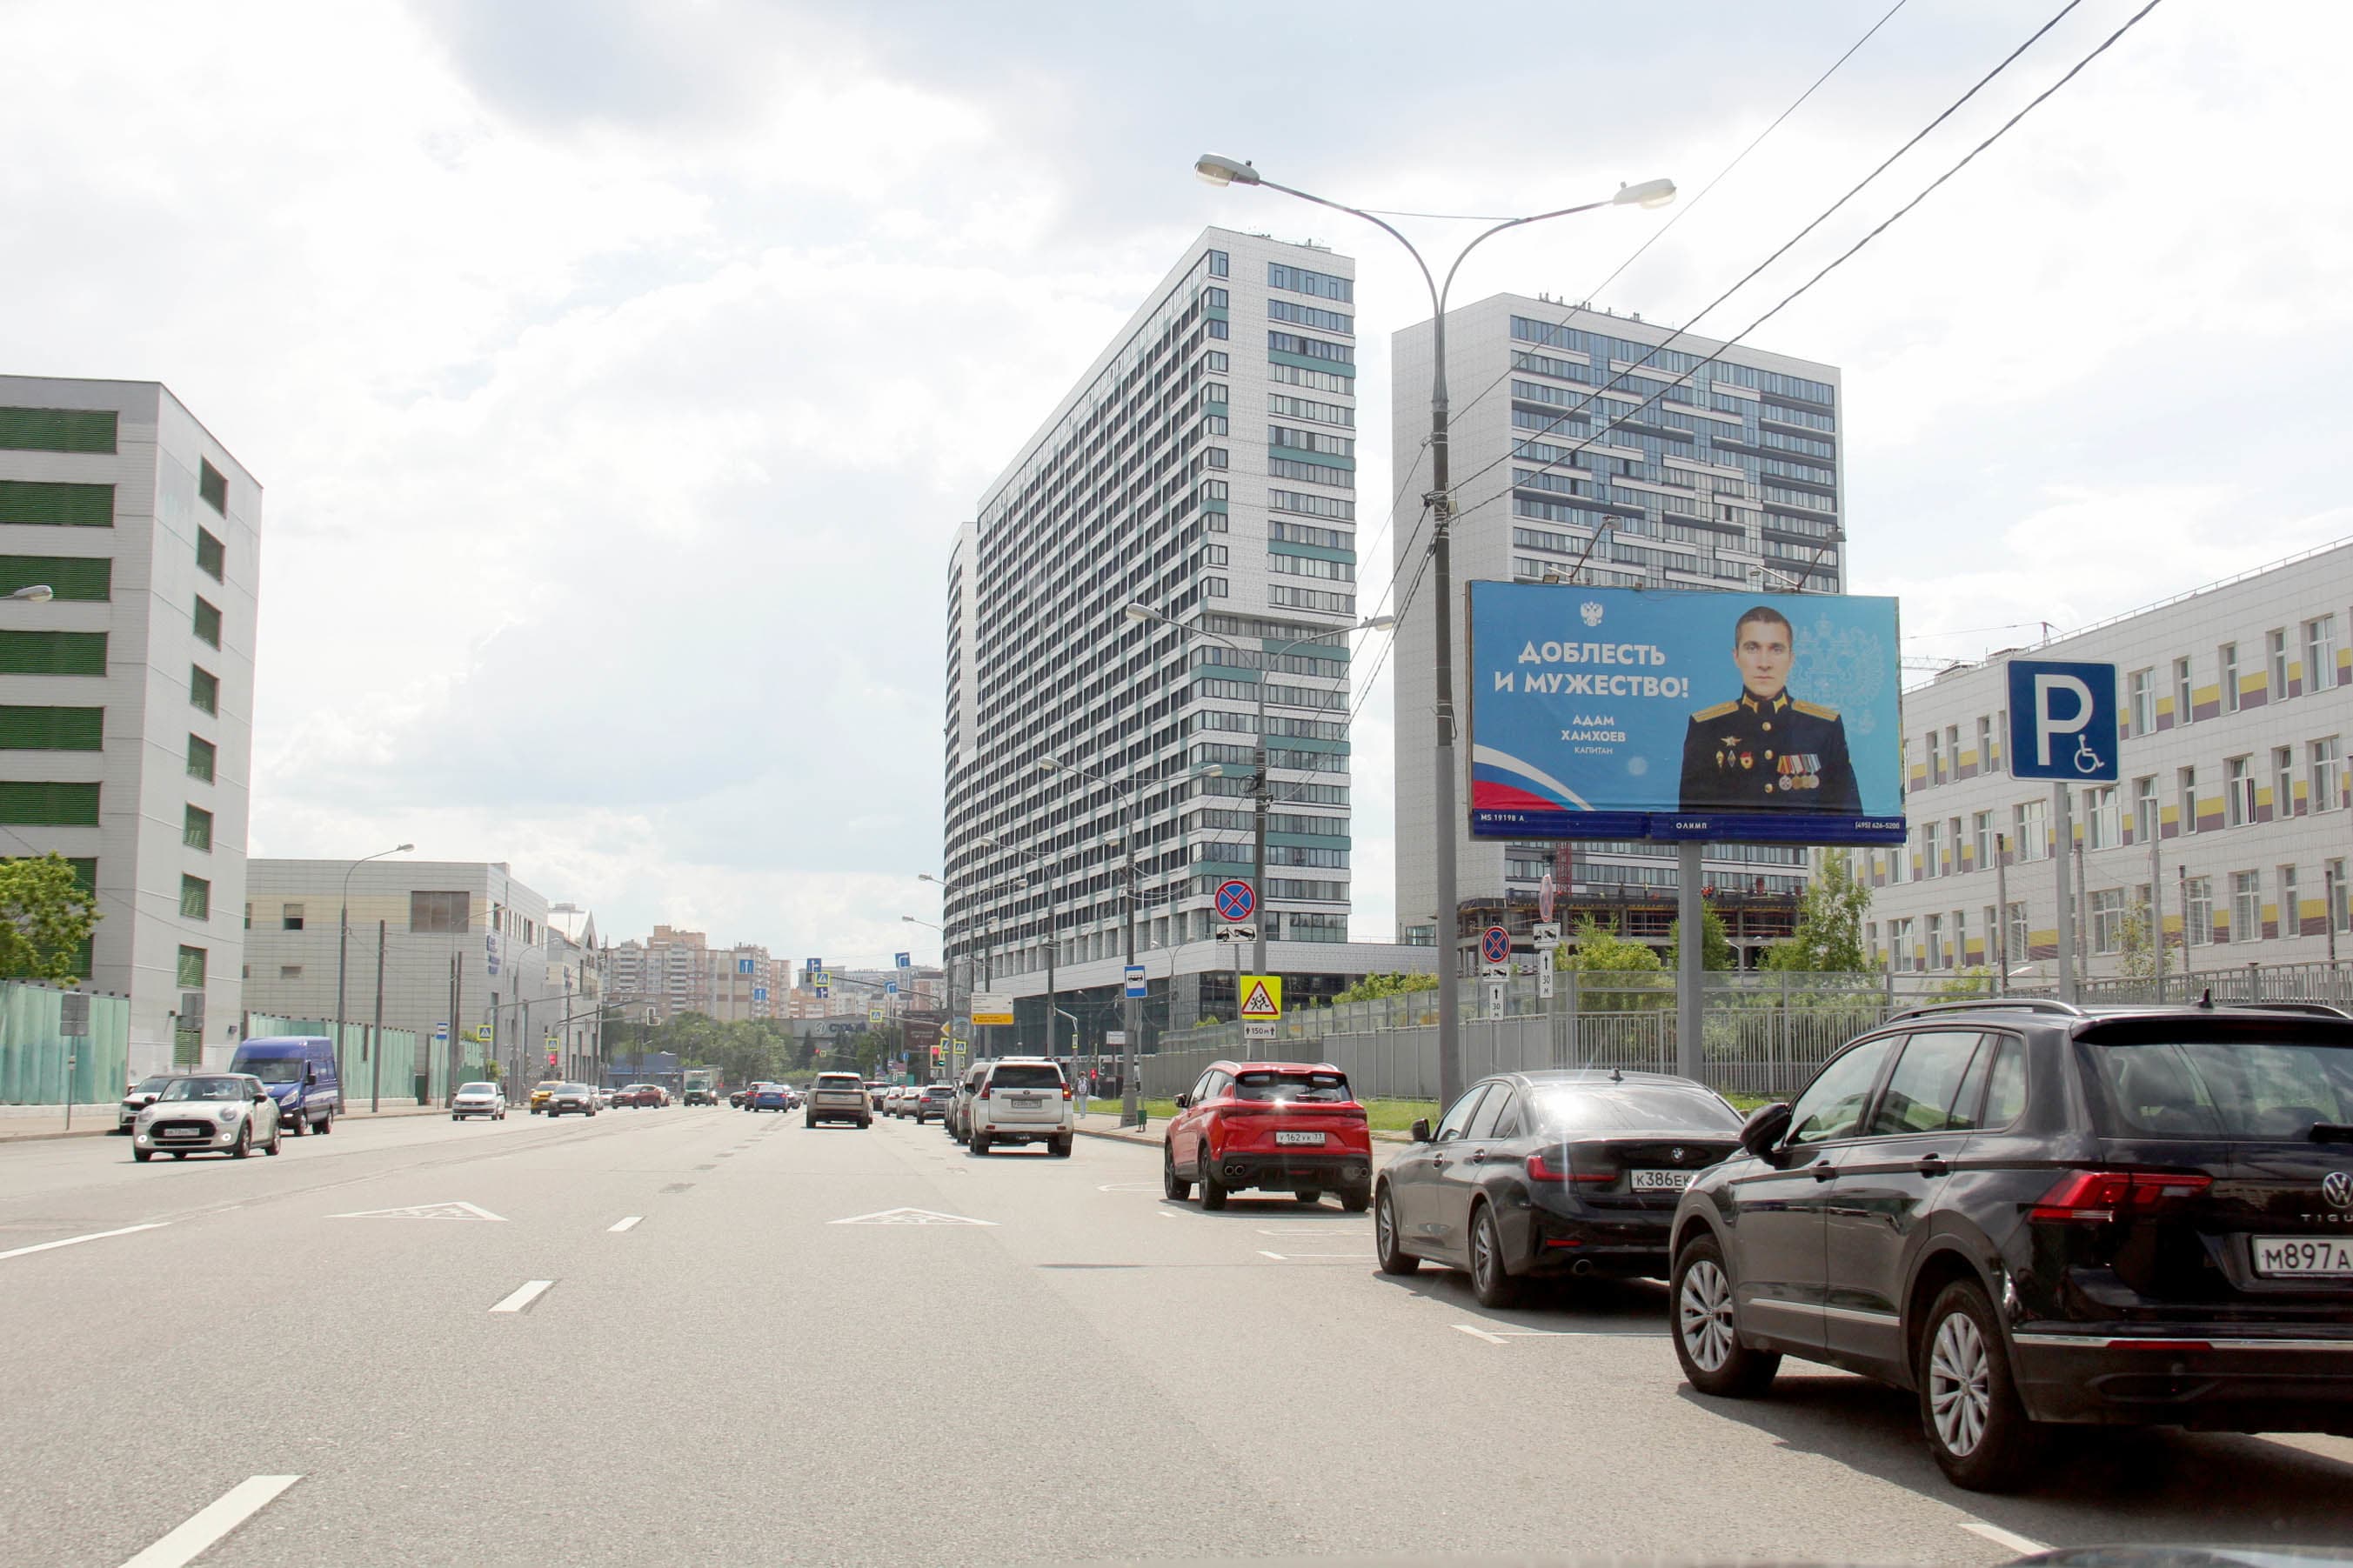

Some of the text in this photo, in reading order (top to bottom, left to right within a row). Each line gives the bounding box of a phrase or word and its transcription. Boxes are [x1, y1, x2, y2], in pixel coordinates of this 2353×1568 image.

[1518, 640, 1666, 665] ДОБЛЕСТЬ
[1494, 671, 1688, 698] И МУЖЕСТВО!
[1572, 715, 1614, 726] АДАМ
[2034, 673, 2094, 766] P
[1561, 730, 1626, 743] ХАМХОЕВ
[1574, 746, 1613, 755] КАПИТАН
[1542, 975, 1551, 984] 30
